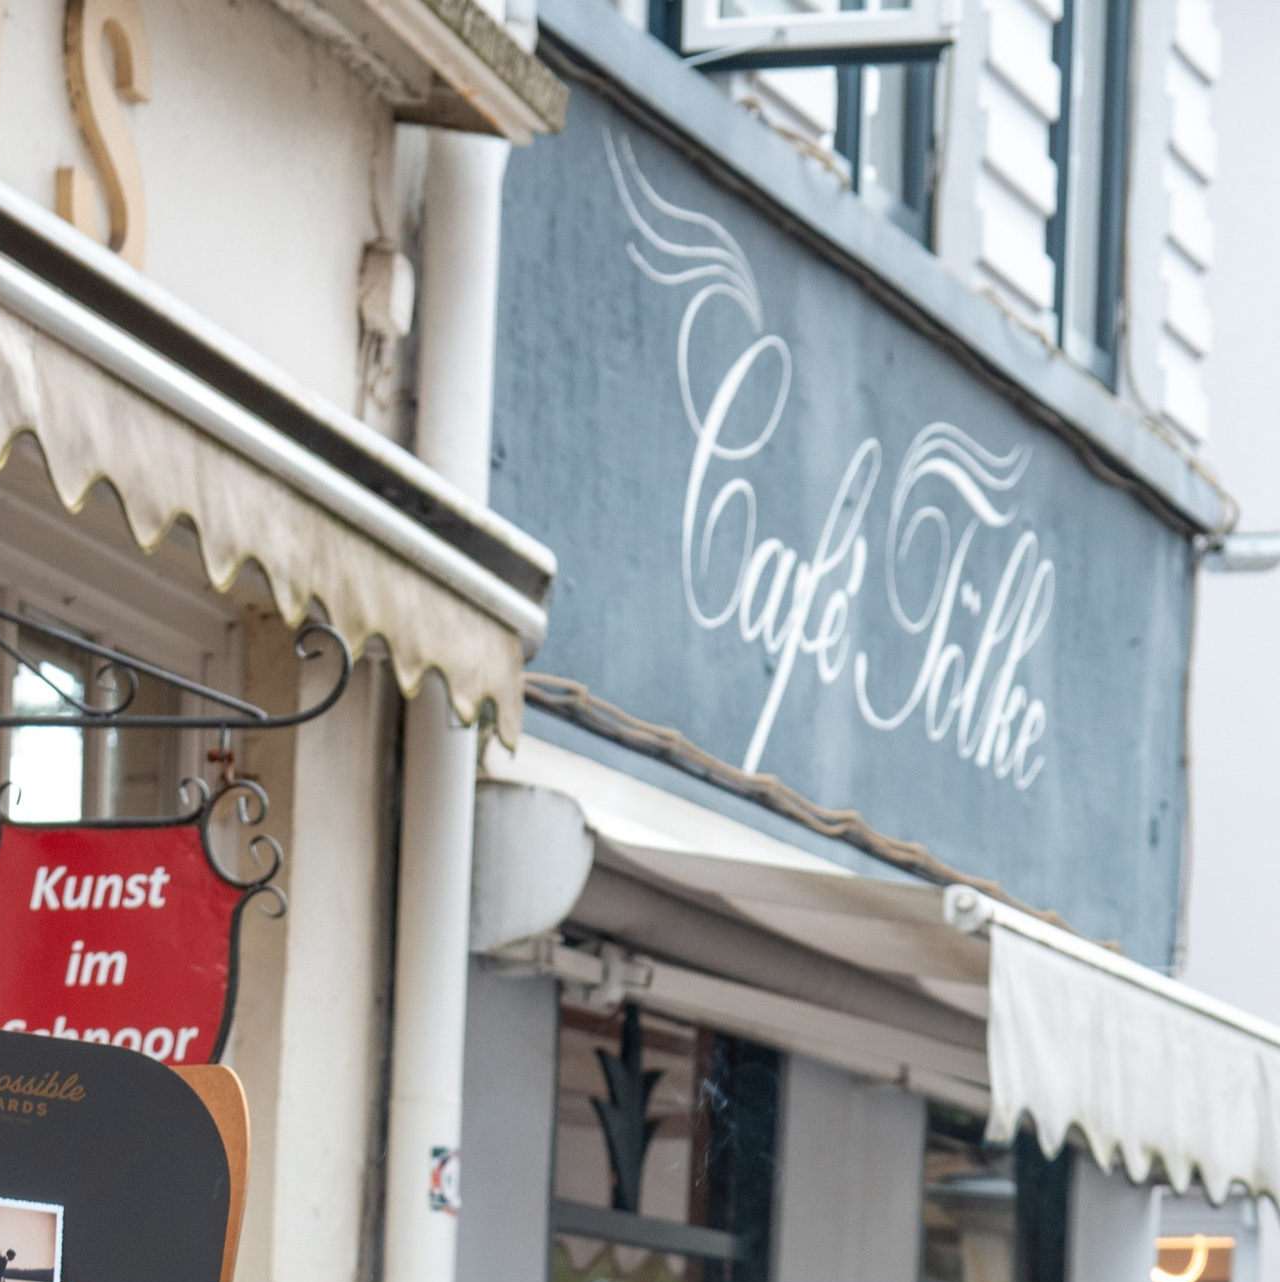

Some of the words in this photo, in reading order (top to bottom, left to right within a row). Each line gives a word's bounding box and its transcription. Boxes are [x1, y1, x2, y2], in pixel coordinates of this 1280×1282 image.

[602, 125, 882, 775] Café
[30, 866, 170, 910] Kunst
[65, 941, 128, 986] im
